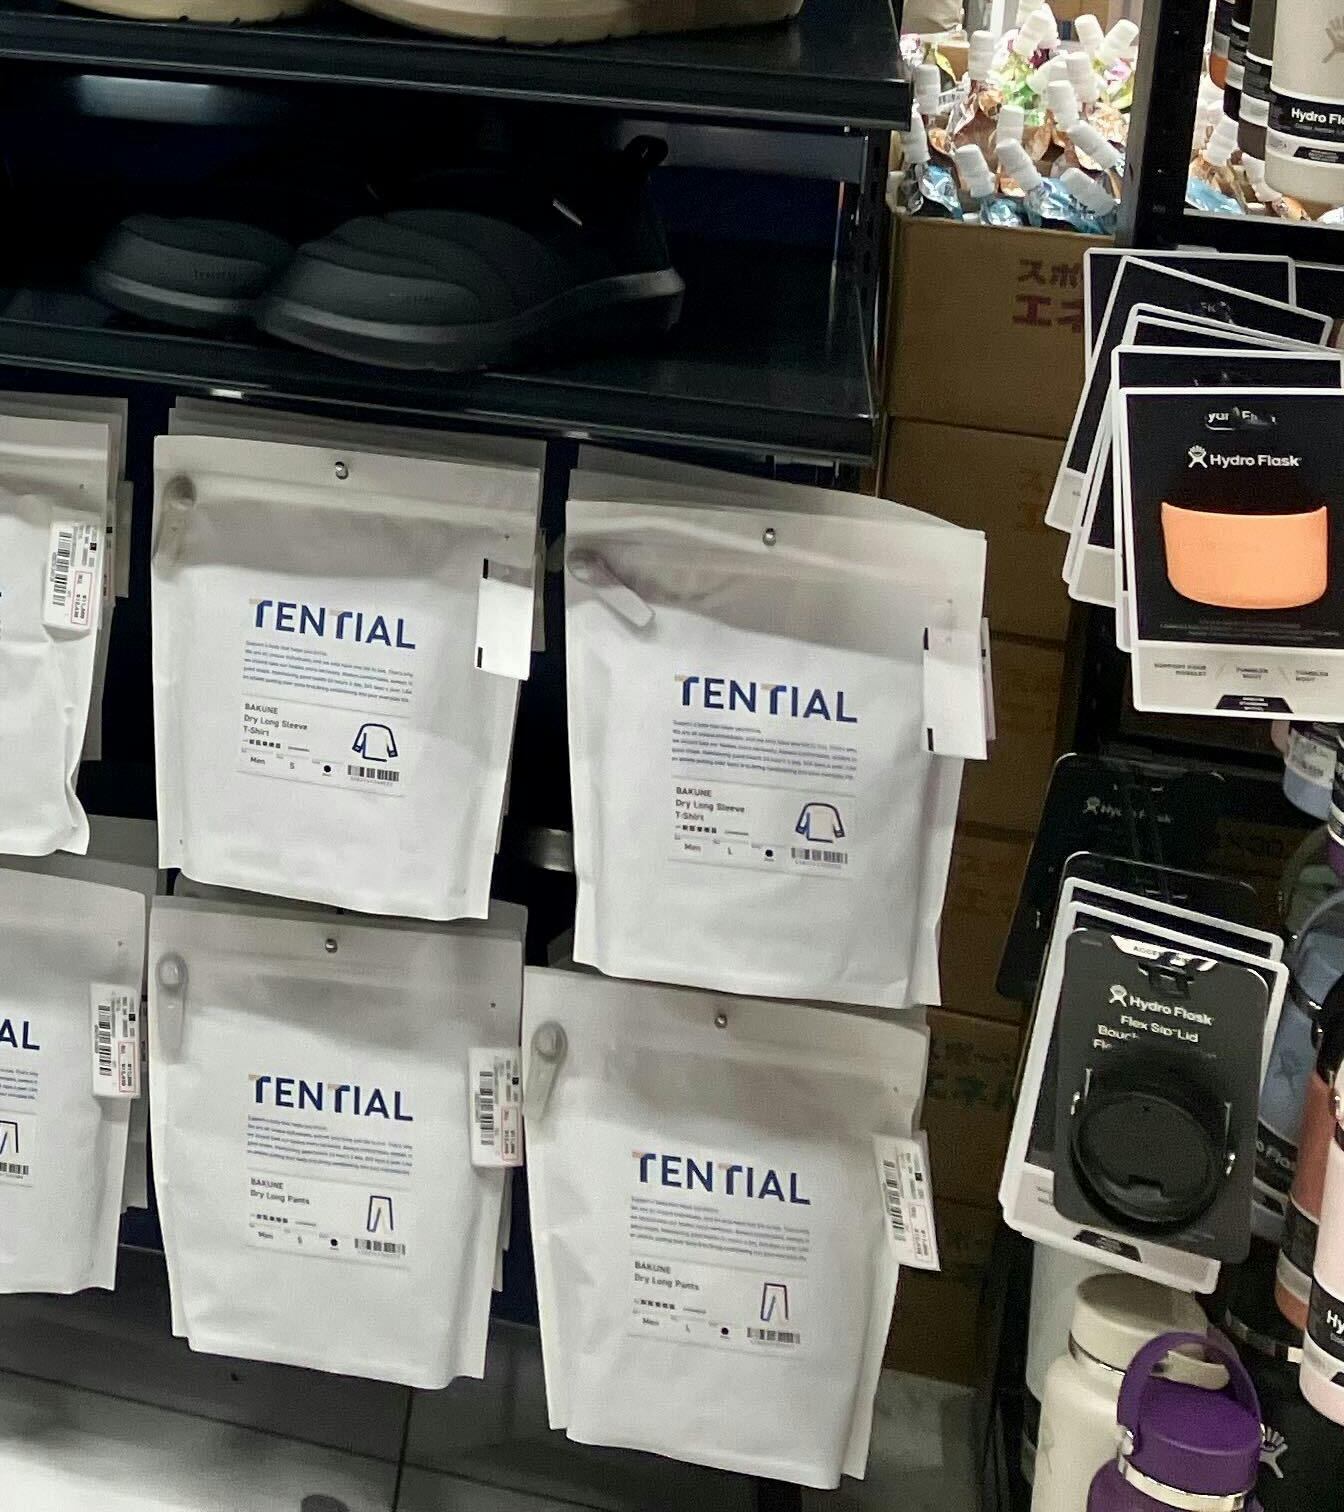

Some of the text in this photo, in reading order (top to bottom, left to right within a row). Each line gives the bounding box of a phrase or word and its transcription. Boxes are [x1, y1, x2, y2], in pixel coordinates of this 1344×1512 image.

[1291, 108, 1327, 125] Hydro
[1209, 454, 1300, 469] Hydro Flask
[249, 598, 417, 651] TENTIAL
[674, 674, 859, 724] TENTIAL
[244, 703, 279, 715] BAKUNE
[243, 714, 308, 731] Dry Long Sleeve
[675, 786, 712, 798] BAKUNE
[675, 798, 745, 814] Dry Long Sleeve
[1129, 995, 1214, 1026] Hydro Flask
[1120, 1015, 1148, 1031] Flex
[248, 1074, 414, 1122] TENTIAL
[632, 1150, 812, 1206] TENTIAL
